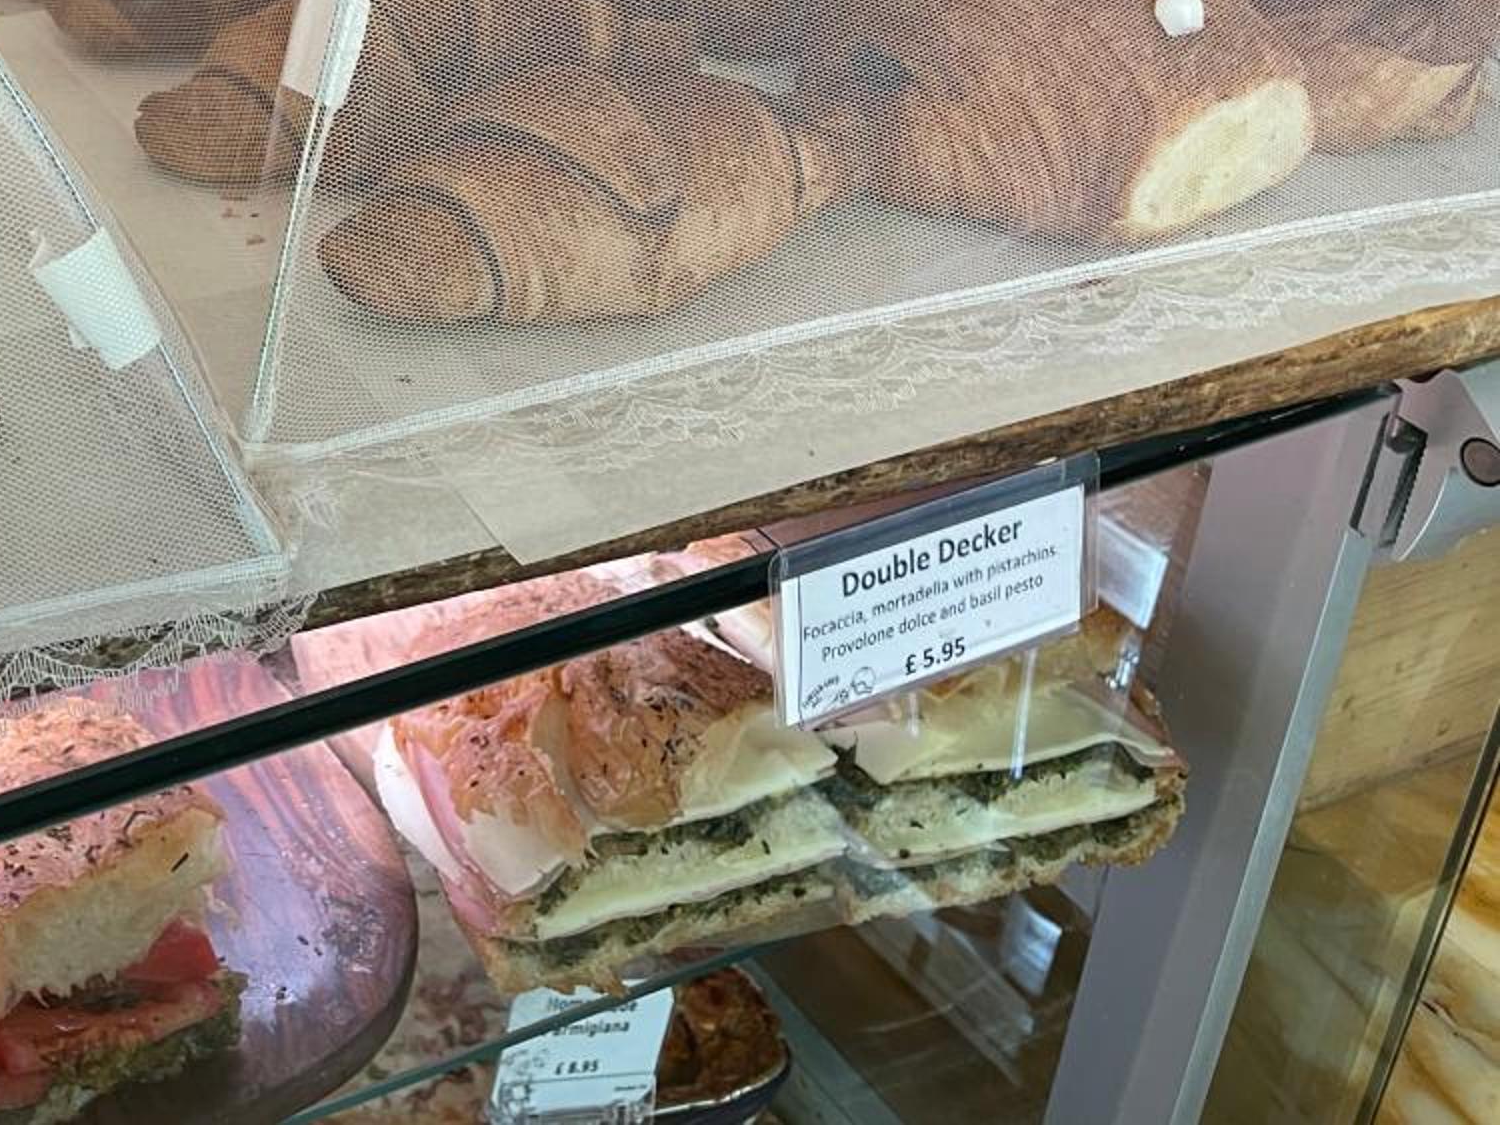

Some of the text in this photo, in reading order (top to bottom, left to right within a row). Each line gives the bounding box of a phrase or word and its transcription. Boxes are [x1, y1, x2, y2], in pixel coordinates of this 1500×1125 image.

[842, 520, 1022, 597] Double Decker
[803, 610, 868, 642] Focaccia,
[872, 579, 949, 616] mortadella
[954, 567, 983, 589] with
[822, 574, 1043, 662] Provolone dolce and basil pesto
[905, 637, 966, 676] £ 5.95
